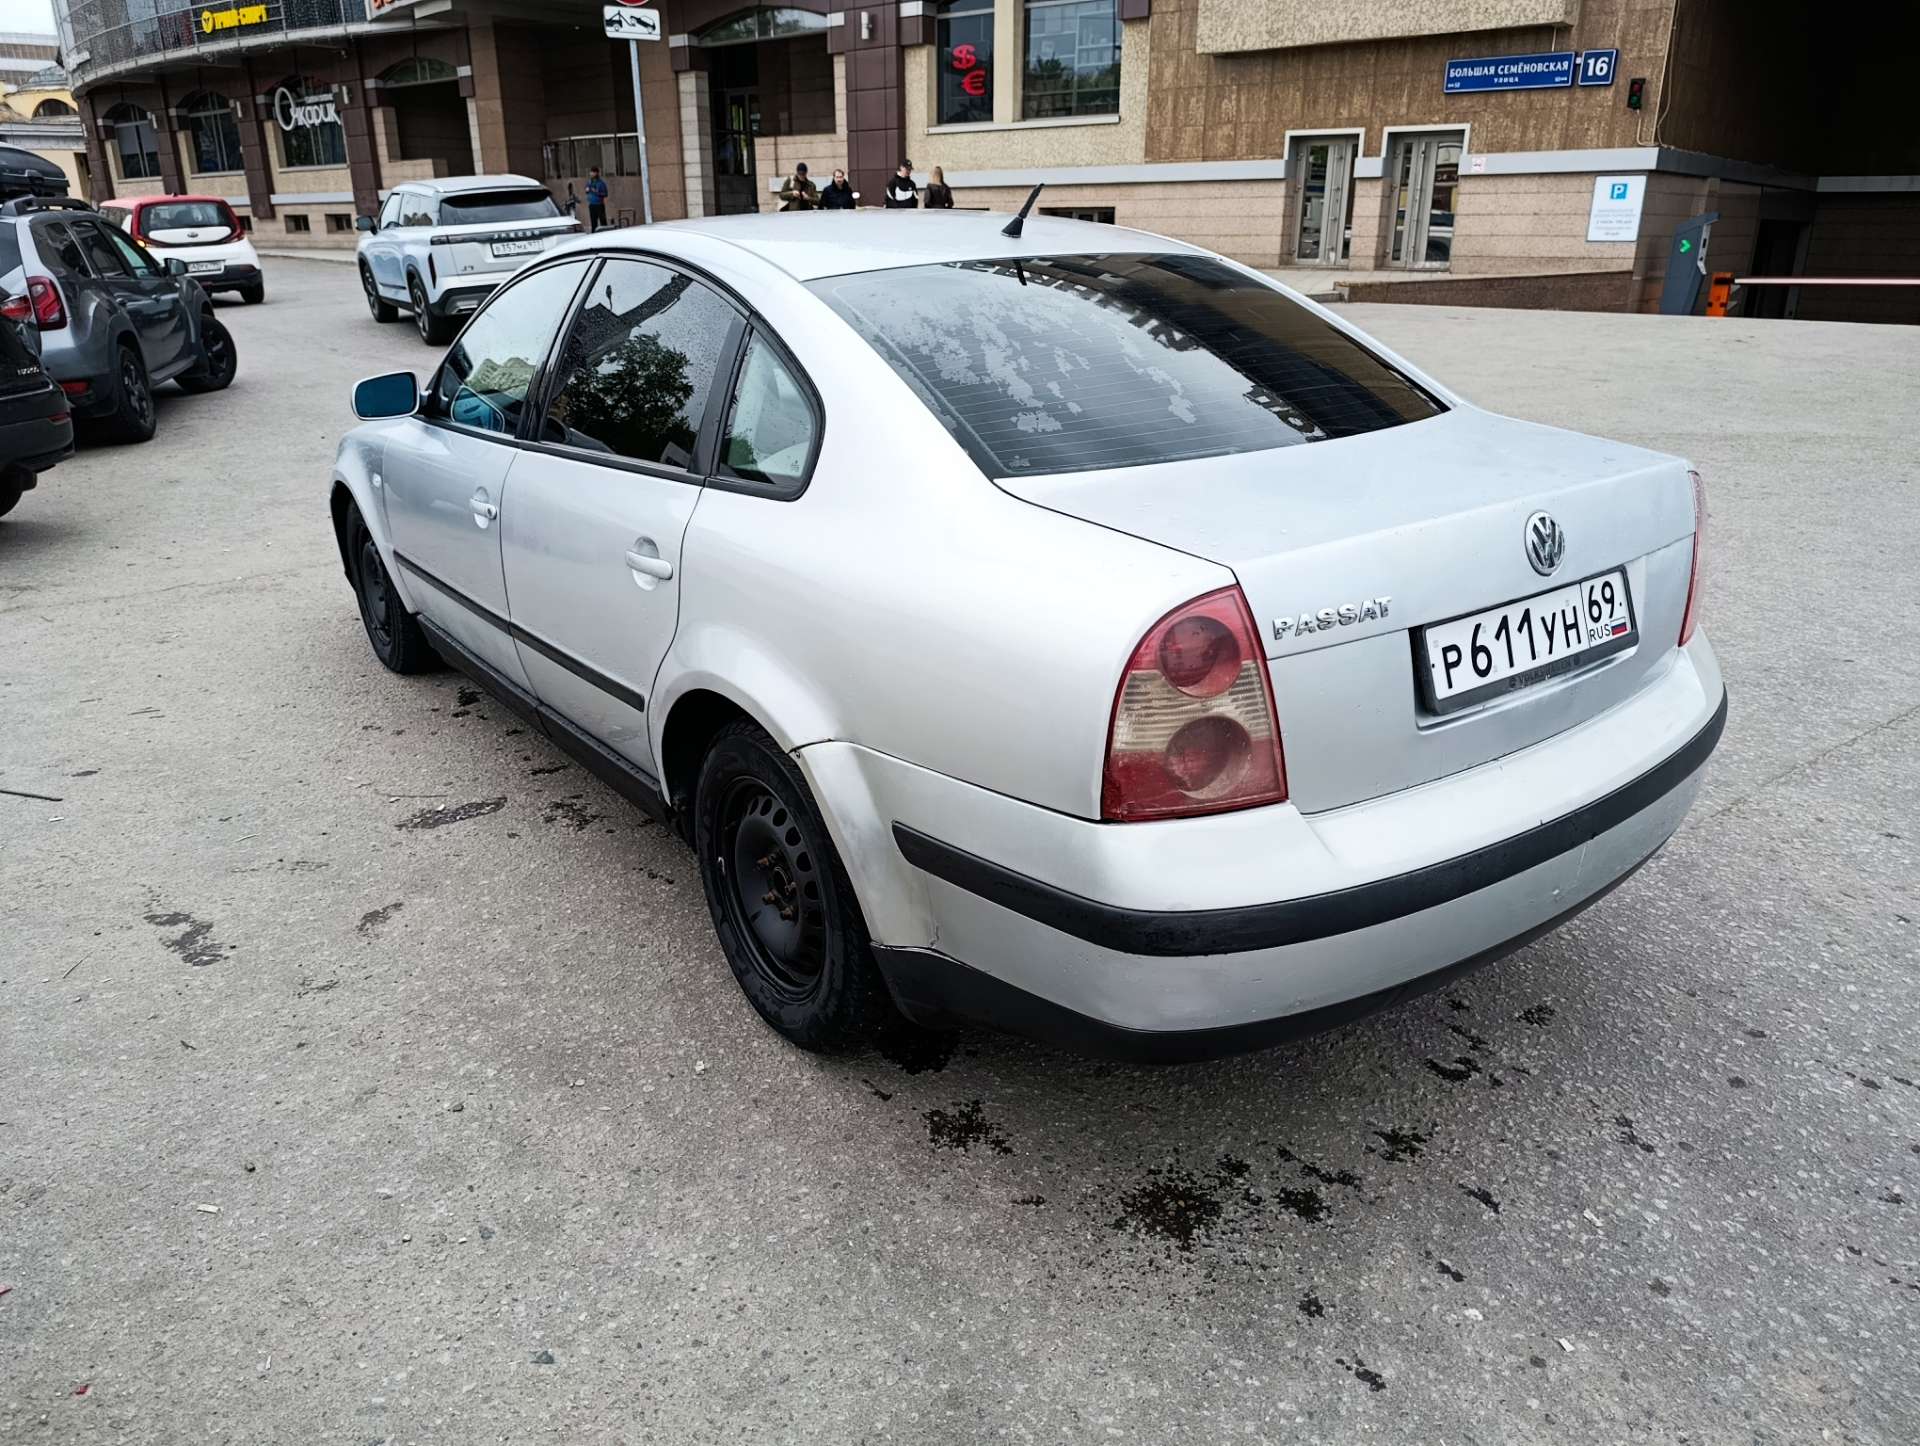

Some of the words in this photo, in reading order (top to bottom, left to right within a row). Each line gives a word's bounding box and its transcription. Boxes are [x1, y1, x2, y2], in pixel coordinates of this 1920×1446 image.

[1449, 66, 1495, 78] БОЛЬШАЯ
[1497, 61, 1569, 75] СЕМЁНОВСКАЯ
[1586, 57, 1609, 77] 16
[275, 87, 341, 131] Очкарик
[1272, 596, 1392, 640] PASSAT
[1588, 580, 1615, 624] 69
[1589, 623, 1611, 642] RUS
